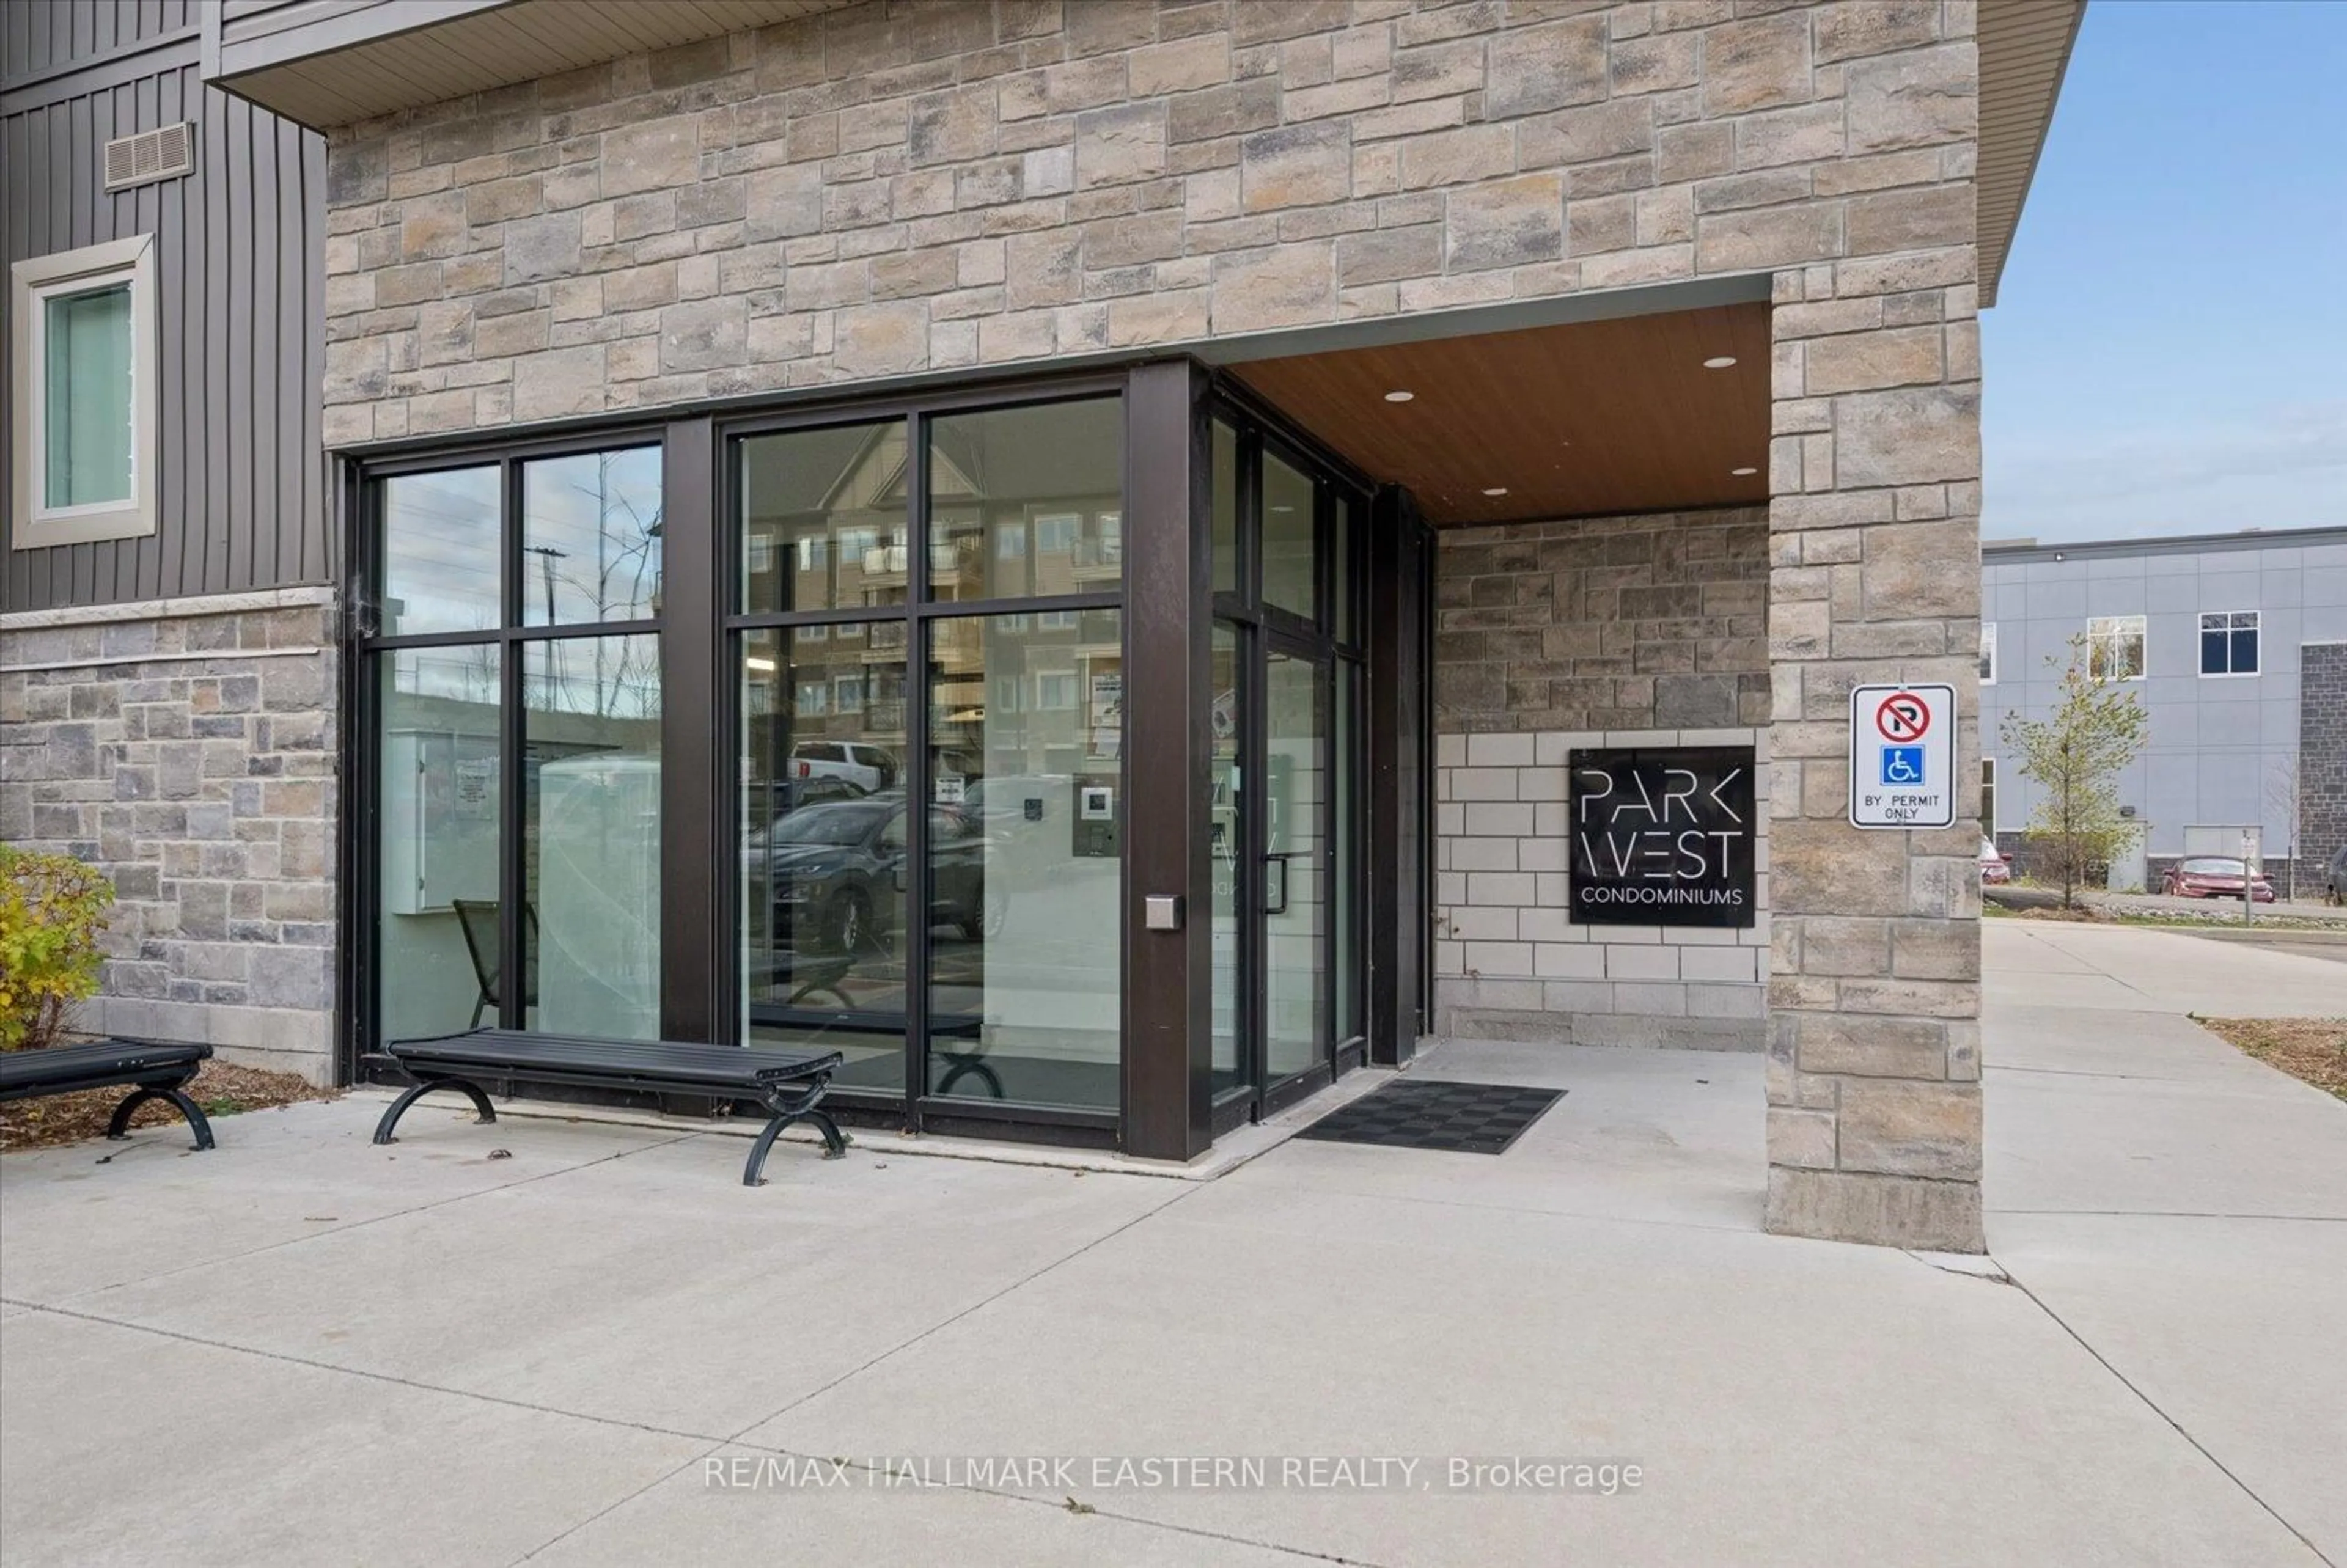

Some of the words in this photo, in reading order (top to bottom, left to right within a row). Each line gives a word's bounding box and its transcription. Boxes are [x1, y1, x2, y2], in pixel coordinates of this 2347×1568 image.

[1581, 768, 1741, 824] PARK
[1865, 795, 1882, 806] BY
[1892, 795, 1940, 806] PERMIT
[1884, 808, 1919, 819] ONLY
[1581, 830, 1743, 879] WEST
[1581, 887, 1743, 905] CONDOMINIUMS
